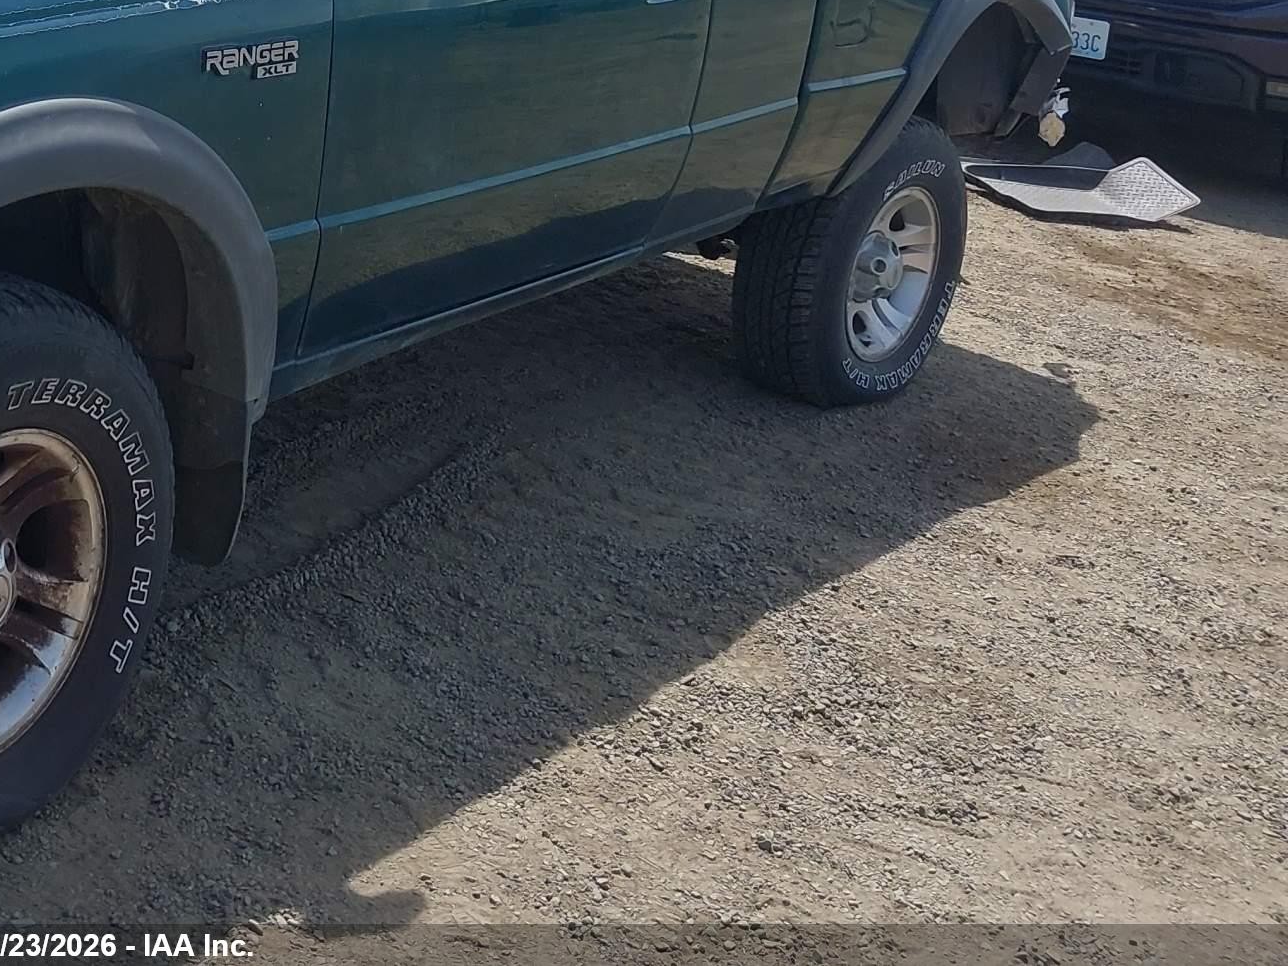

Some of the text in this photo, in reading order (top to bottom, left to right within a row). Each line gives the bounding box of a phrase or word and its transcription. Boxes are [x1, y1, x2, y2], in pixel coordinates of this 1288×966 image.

[261, 62, 294, 76] XLT
[841, 356, 871, 390] H/T
[7, 377, 156, 674] TERRAMAX H/T
